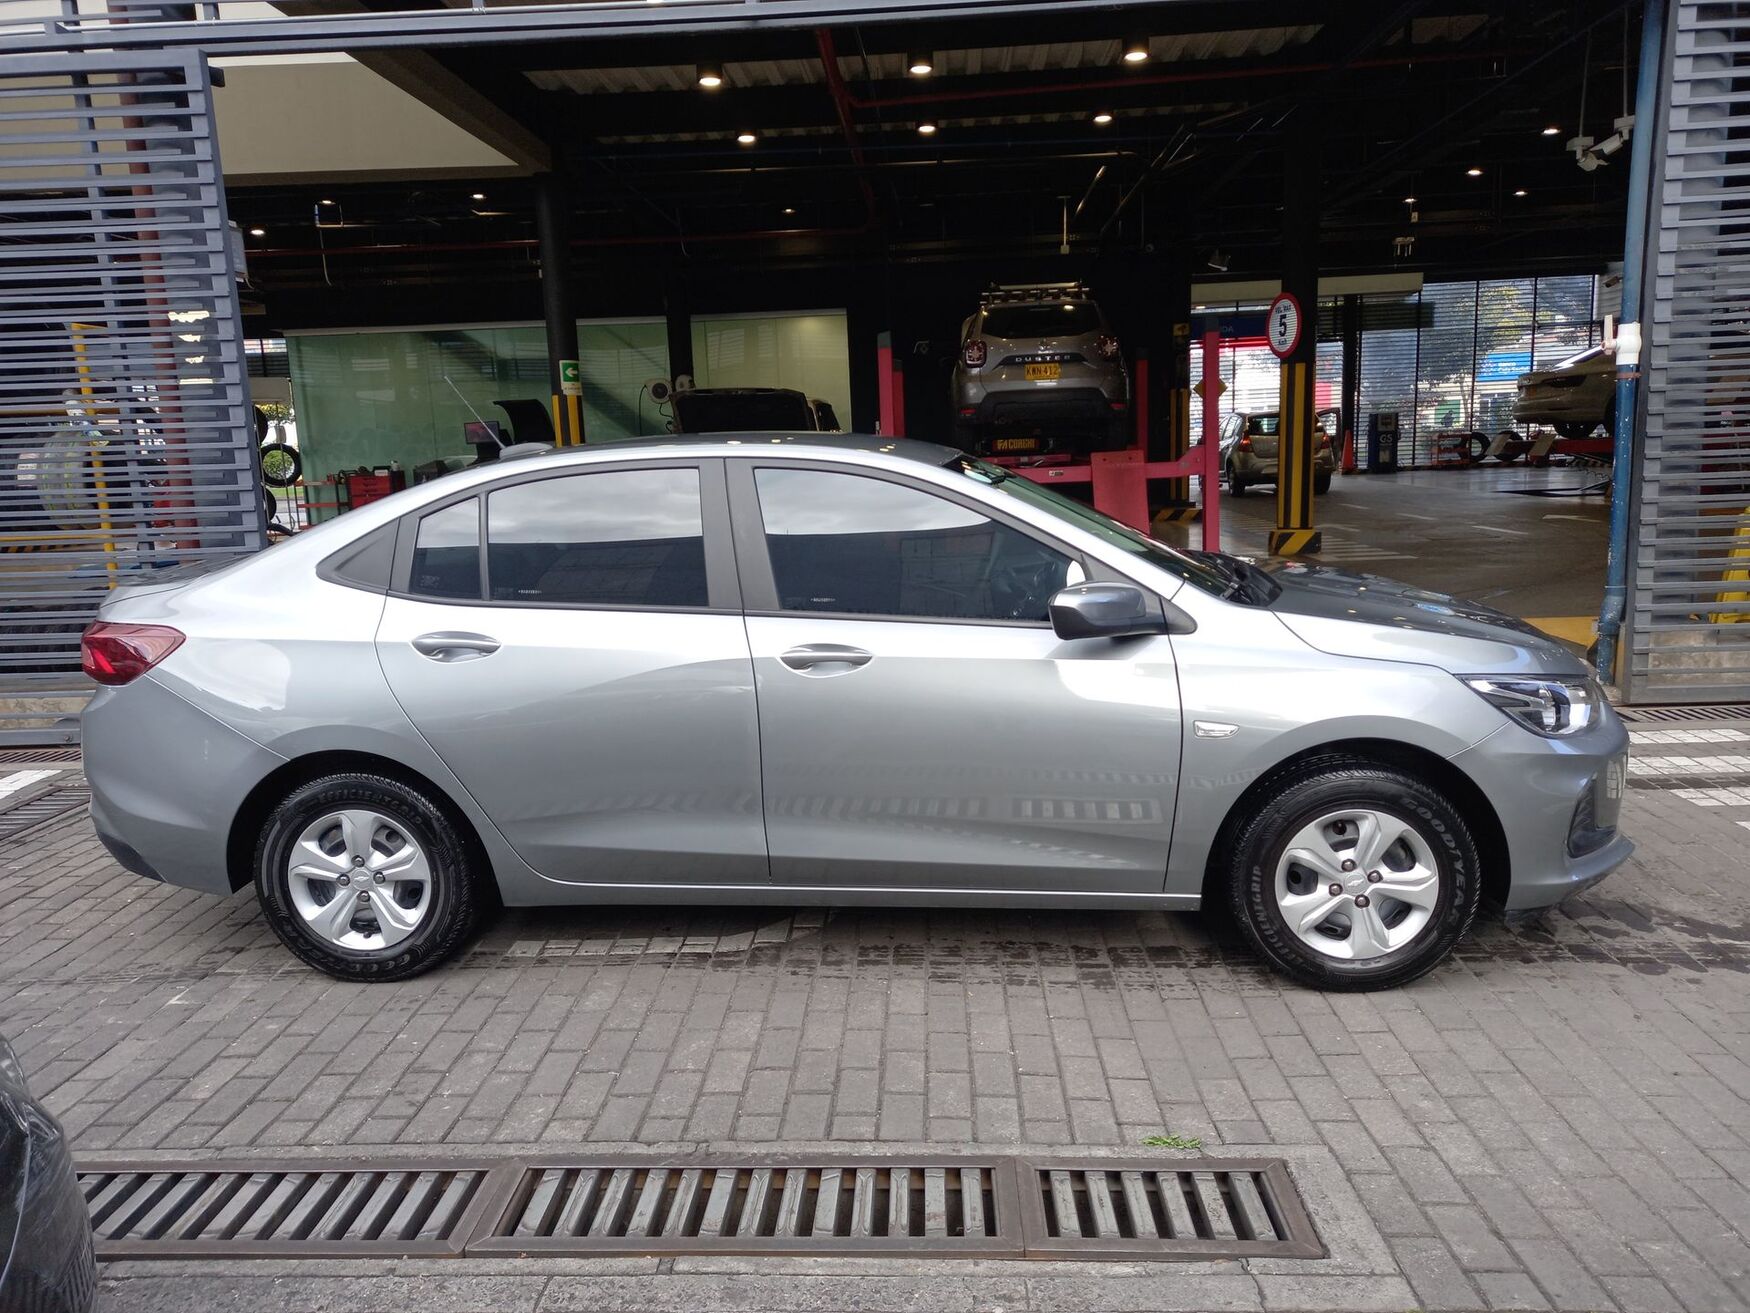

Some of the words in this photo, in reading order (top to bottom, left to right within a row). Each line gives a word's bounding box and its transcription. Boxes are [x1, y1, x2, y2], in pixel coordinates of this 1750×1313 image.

[1279, 314, 1287, 337] 5
[1401, 797, 1467, 926] GOODYEAR
[1251, 864, 1308, 967] EFFICIENTGRIP
